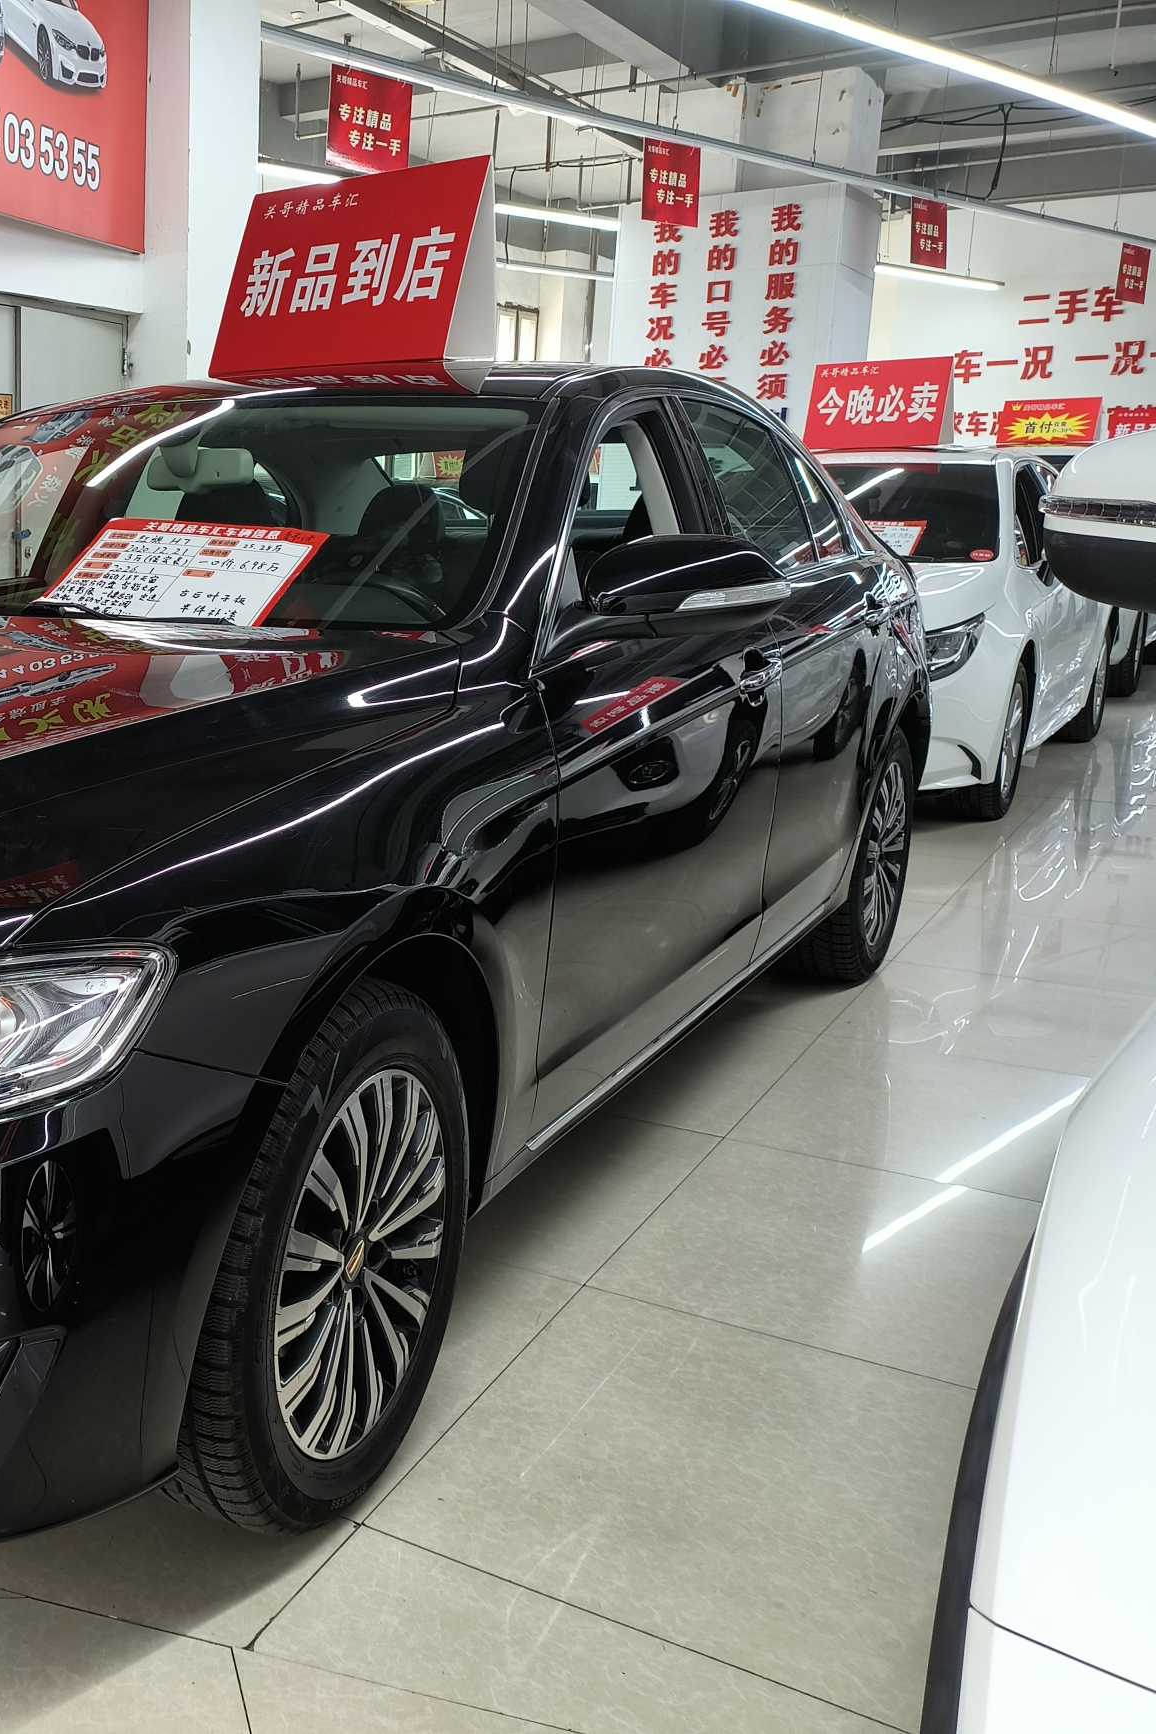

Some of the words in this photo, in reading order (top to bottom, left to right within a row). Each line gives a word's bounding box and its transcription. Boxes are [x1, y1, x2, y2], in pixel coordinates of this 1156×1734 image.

[338, 103, 392, 132] 专注精品
[348, 129, 401, 157] 专注一手
[649, 168, 687, 188] 专注精品
[263, 193, 360, 220] 关哥精品车汇
[656, 189, 694, 208] 专注一手
[240, 225, 456, 317] 新品到店
[698, 209, 740, 384] 我的口号必
[755, 203, 804, 400] 我的服务必须
[1018, 286, 1125, 325] 二手车
[820, 366, 882, 379] 关哥精品车汇
[816, 381, 940, 426] 今晚必卖
[1025, 421, 1052, 434] 首付
[143, 521, 282, 541] 关哥精品车汇车辆信息
